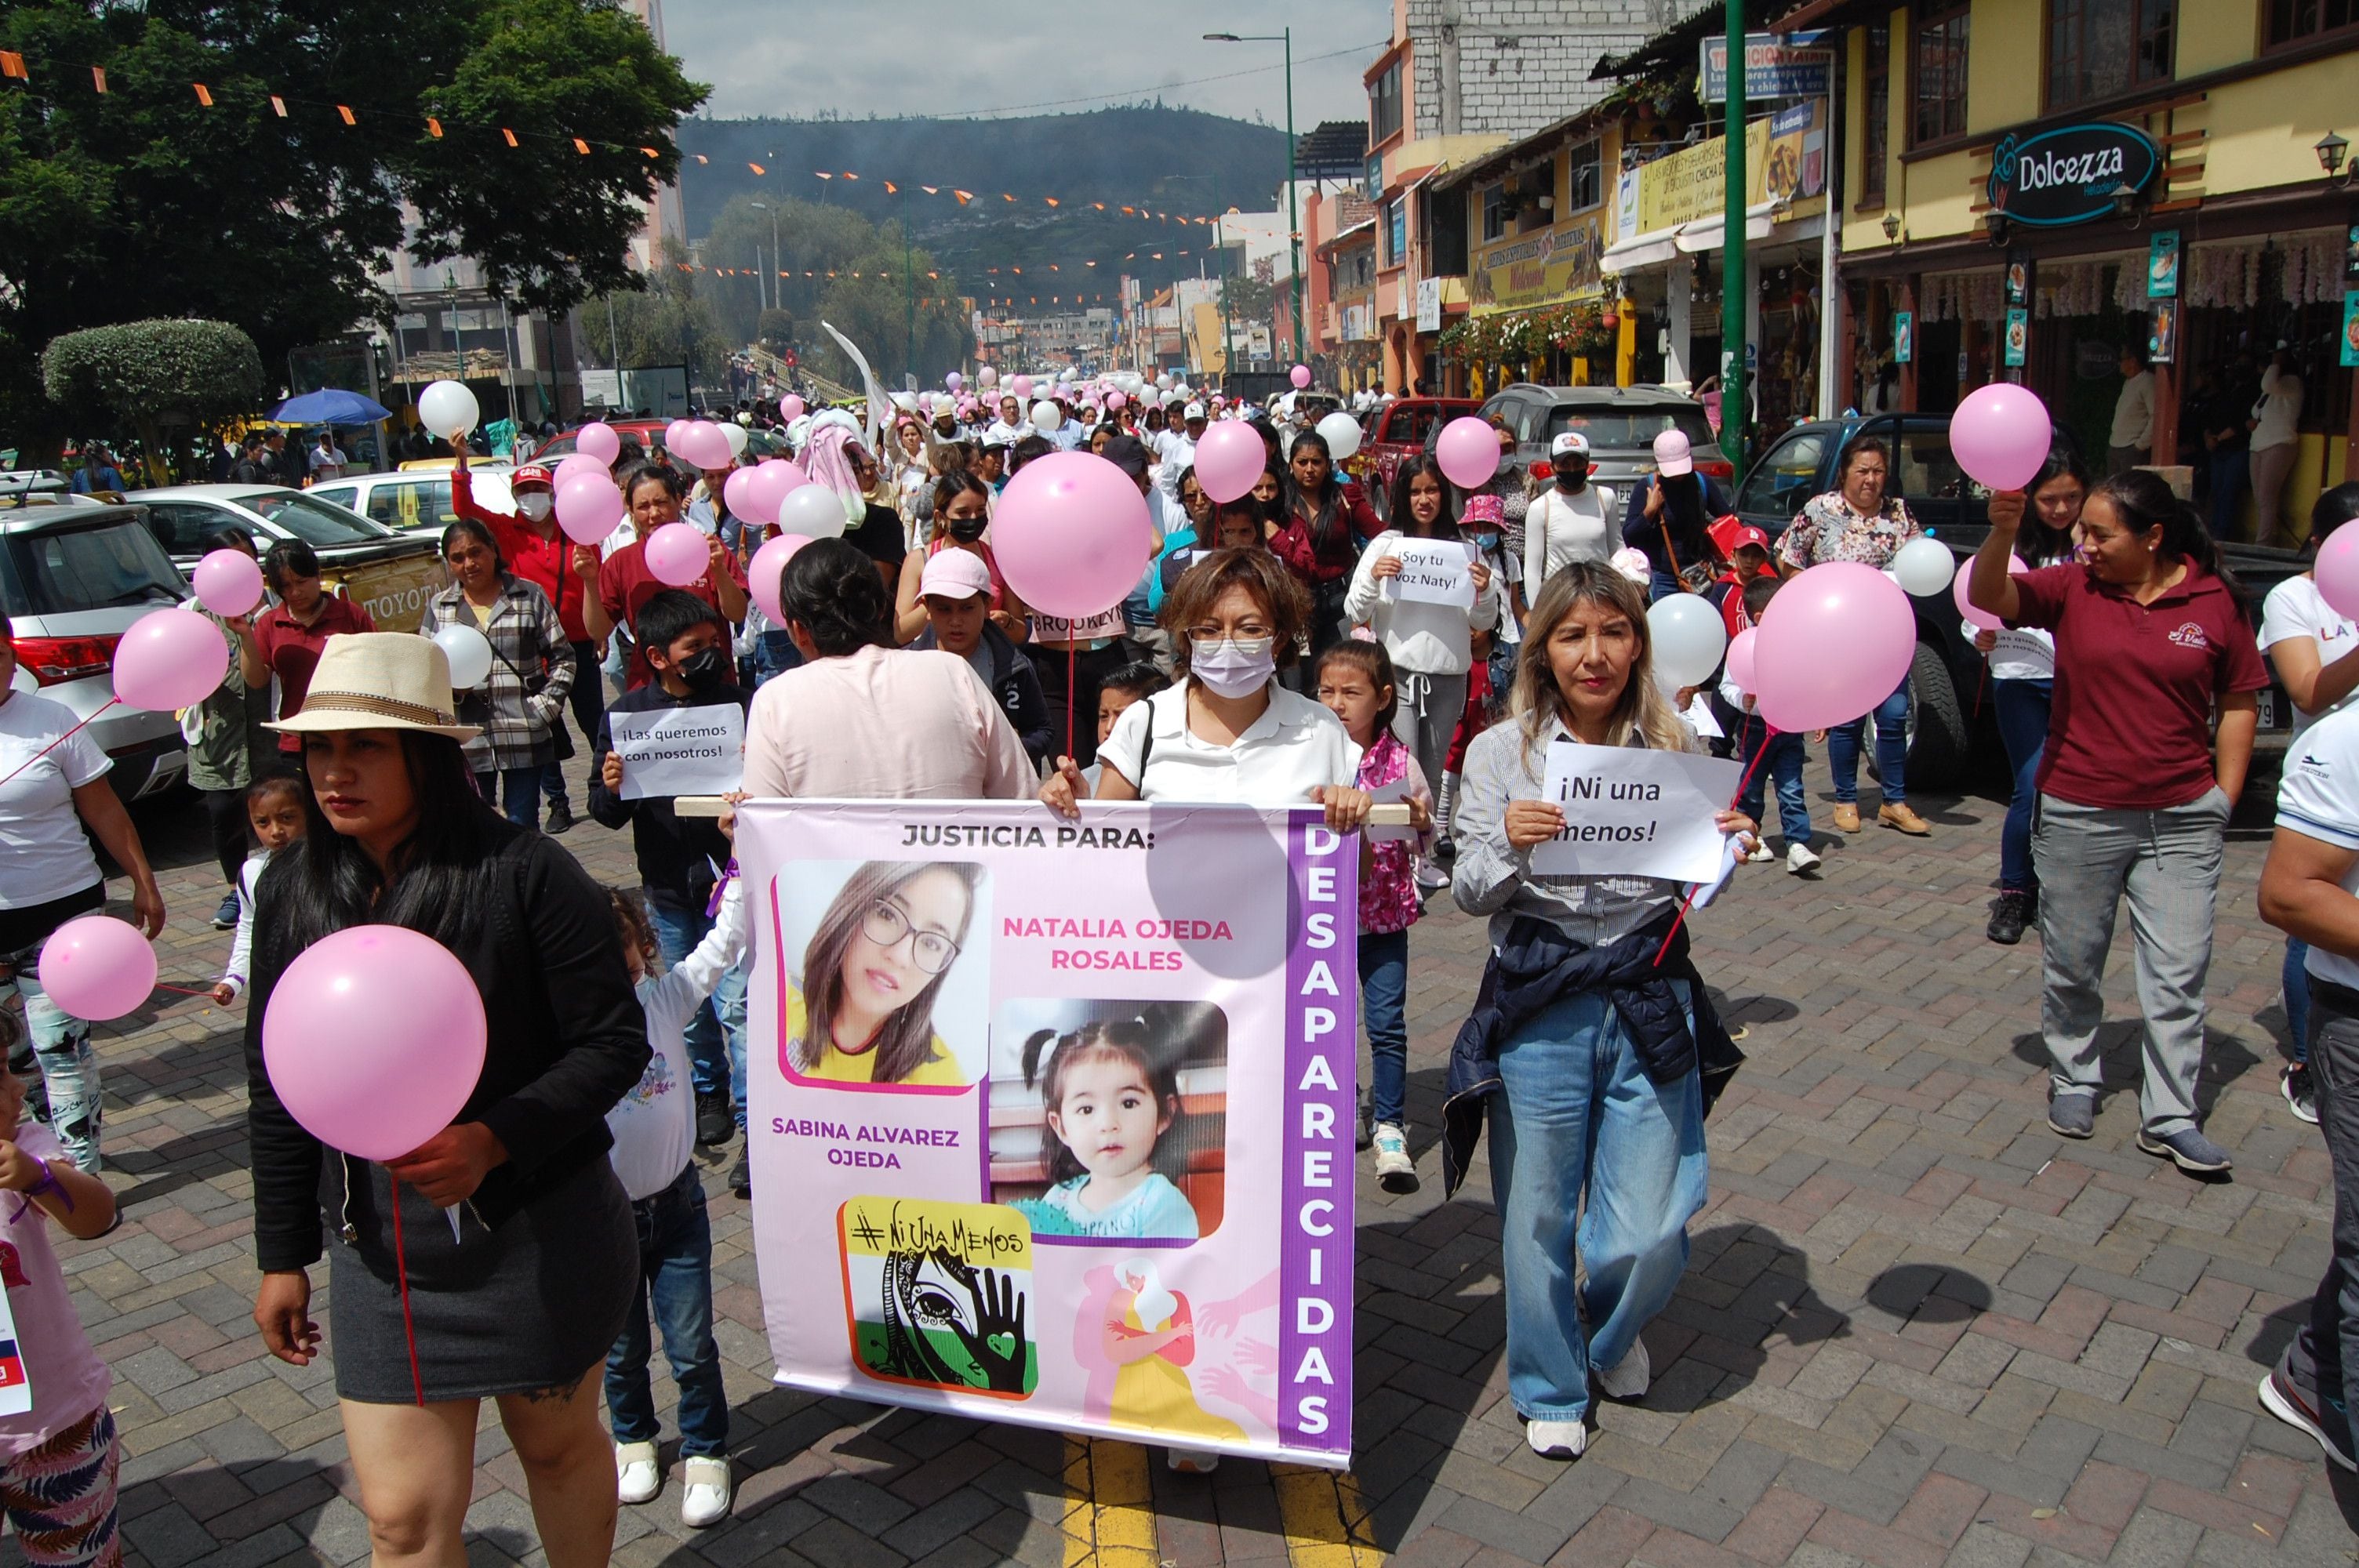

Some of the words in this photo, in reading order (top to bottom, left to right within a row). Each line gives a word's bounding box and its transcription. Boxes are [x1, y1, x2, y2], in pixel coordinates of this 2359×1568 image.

[1710, 47, 1784, 70] TRICION
[2019, 147, 2123, 191] Dolcezza
[1430, 555, 1444, 565] tu
[1420, 574, 1457, 590] Naty!
[1006, 690, 1020, 710] 2
[623, 729, 651, 742] ¡Las
[655, 726, 727, 742] queremos
[625, 752, 650, 761] con
[655, 746, 722, 760] nosotros!
[1561, 776, 1602, 801] ¡Ni
[1610, 782, 1661, 801] una
[901, 825, 1047, 848] JUSTICIA
[1056, 826, 1155, 850] PARA:
[1553, 820, 1657, 842] menos!
[1004, 917, 1127, 938] NATALIA
[1136, 919, 1234, 941] OJEDA
[1051, 949, 1183, 971] ROSALES
[772, 1117, 851, 1141] SABINA
[856, 1125, 960, 1148] ALVAREZ
[1295, 823, 1341, 1436] DESAPARECIDAS
[827, 1149, 902, 1169] OJEDA
